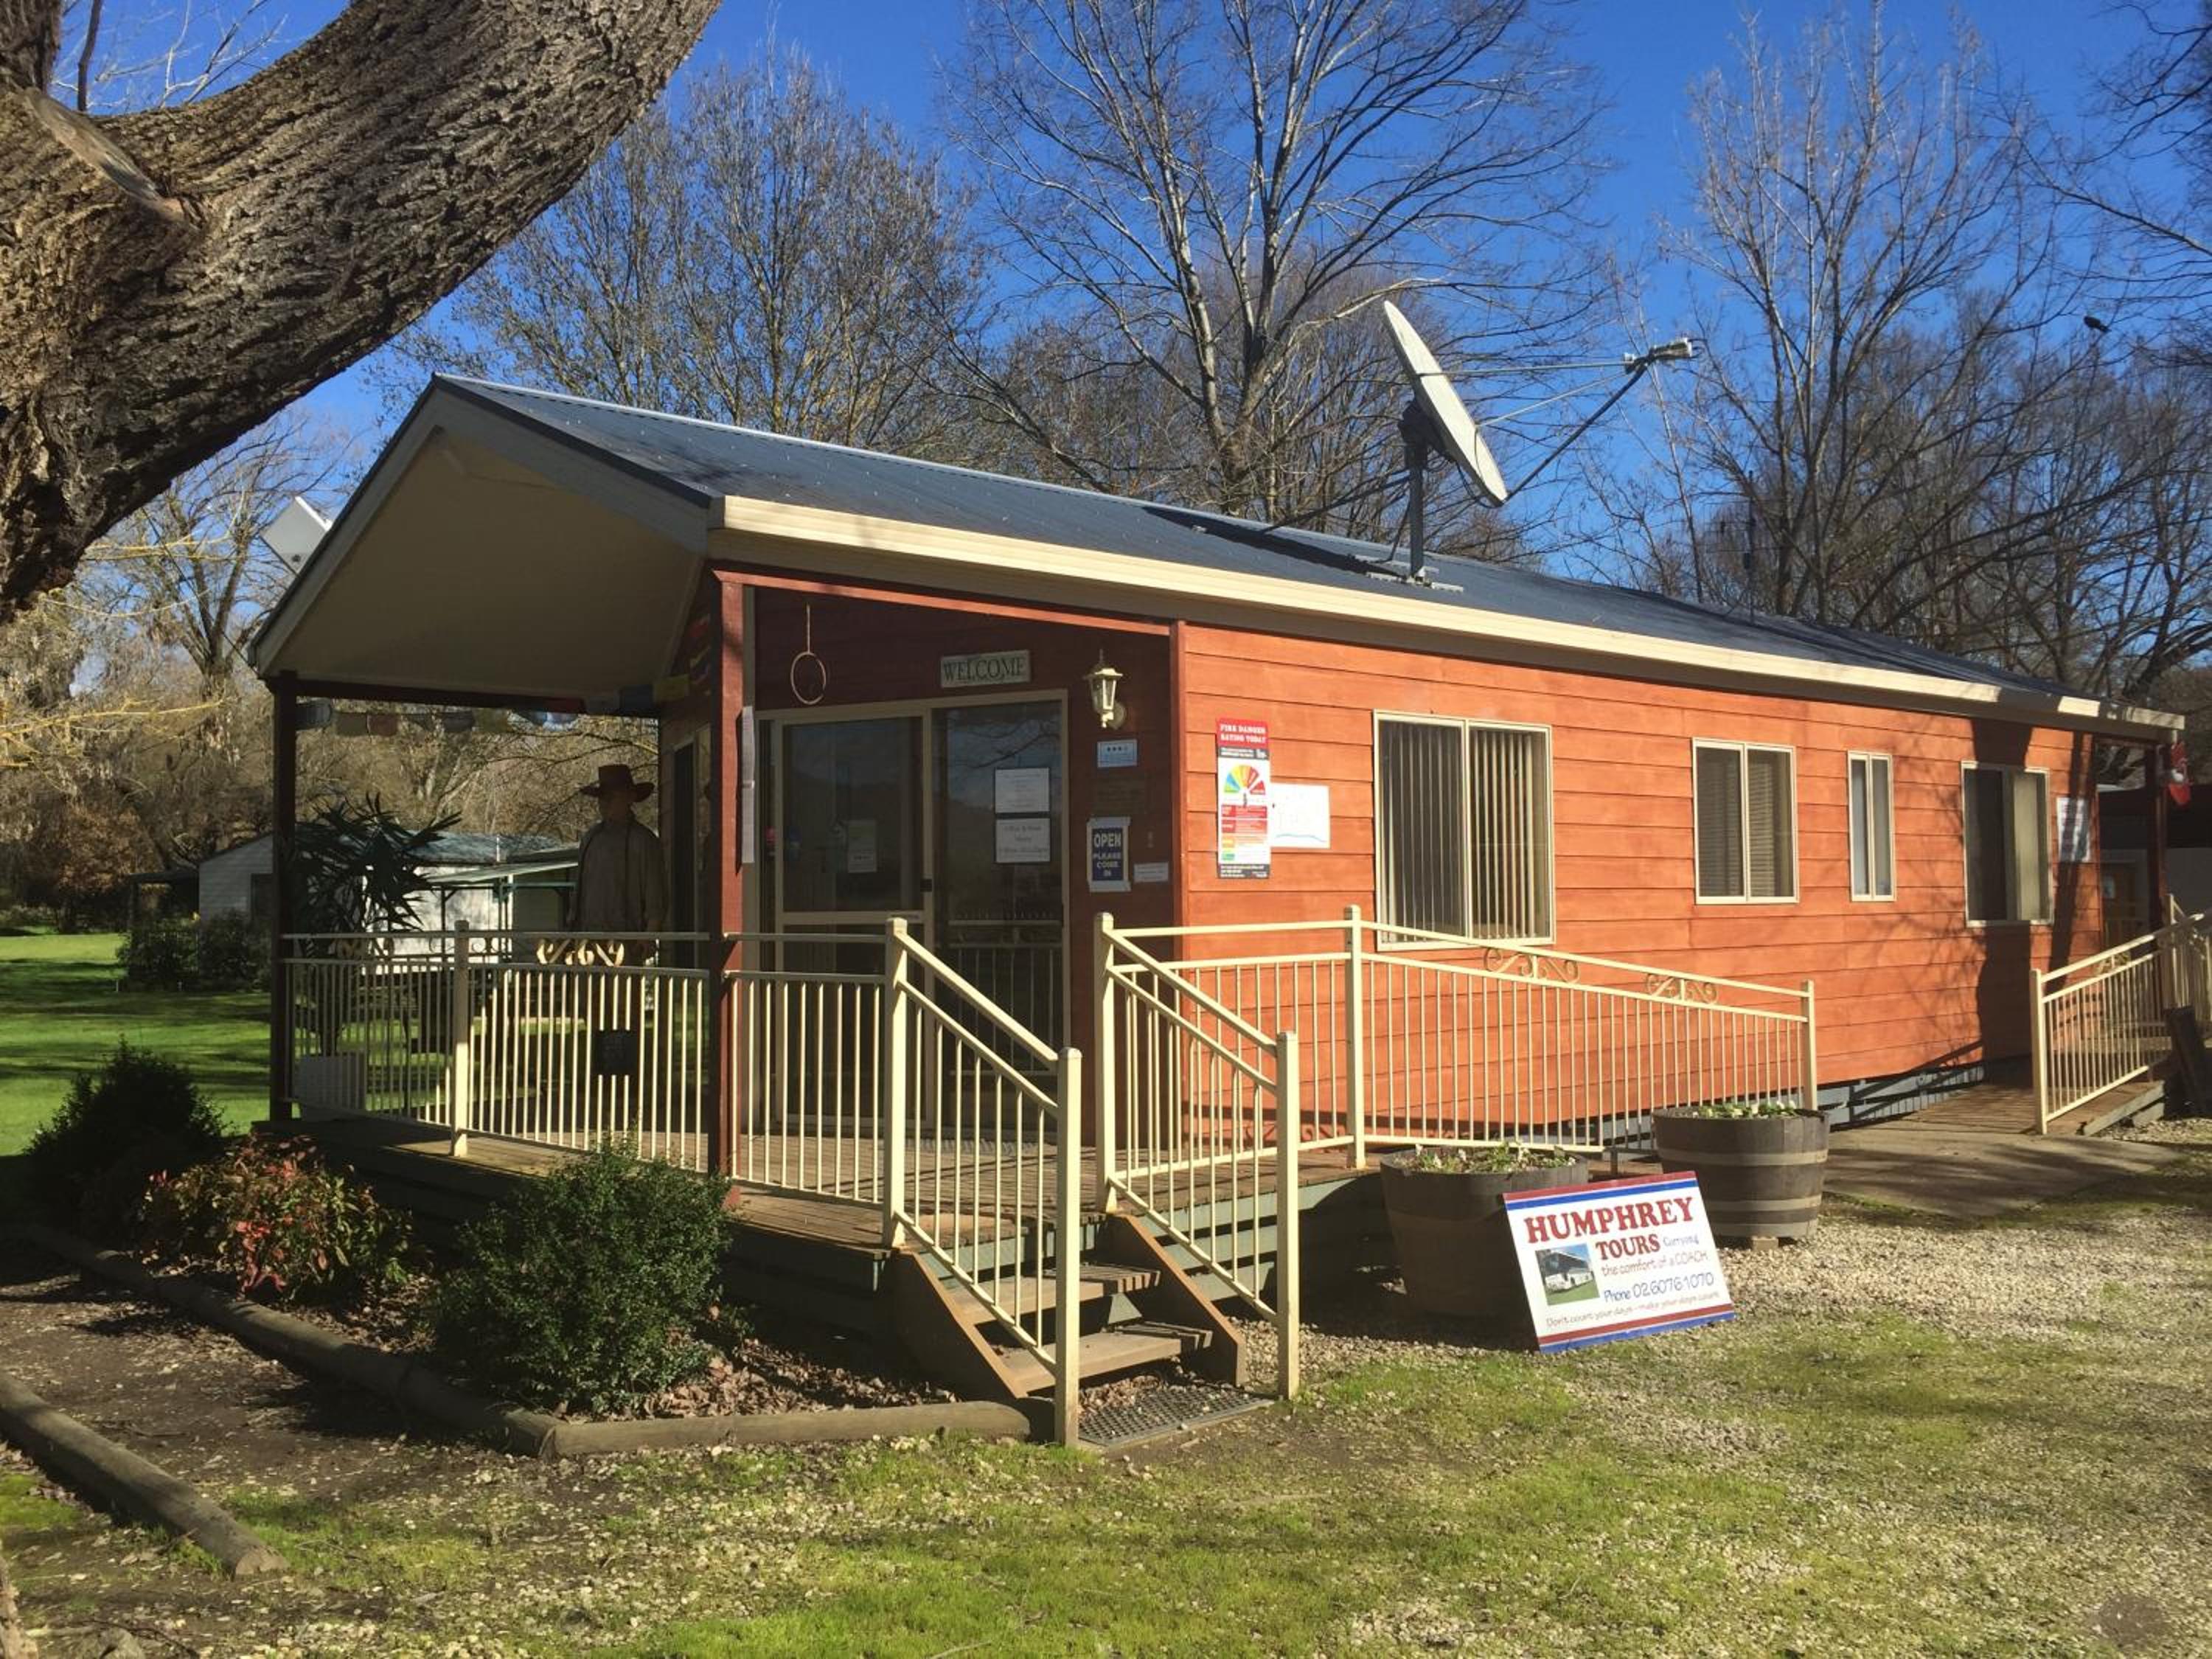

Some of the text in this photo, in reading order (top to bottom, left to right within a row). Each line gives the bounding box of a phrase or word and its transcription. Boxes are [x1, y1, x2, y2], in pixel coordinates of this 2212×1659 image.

[943, 656, 1026, 681] WELCOME
[1220, 723, 1266, 734] FIRE DANGER
[1220, 733, 1267, 744] RATING TODAY
[1093, 832, 1121, 848] OPEN
[1093, 852, 1121, 860] PLEASE
[1523, 1197, 1693, 1243] HUMPHREY
[1596, 1234, 1660, 1260] TOURS
[1601, 1263, 1618, 1276] the
[1619, 1259, 1655, 1274] comfort
[1675, 1250, 1708, 1265] COACH
[1604, 1287, 1632, 1303] Phone
